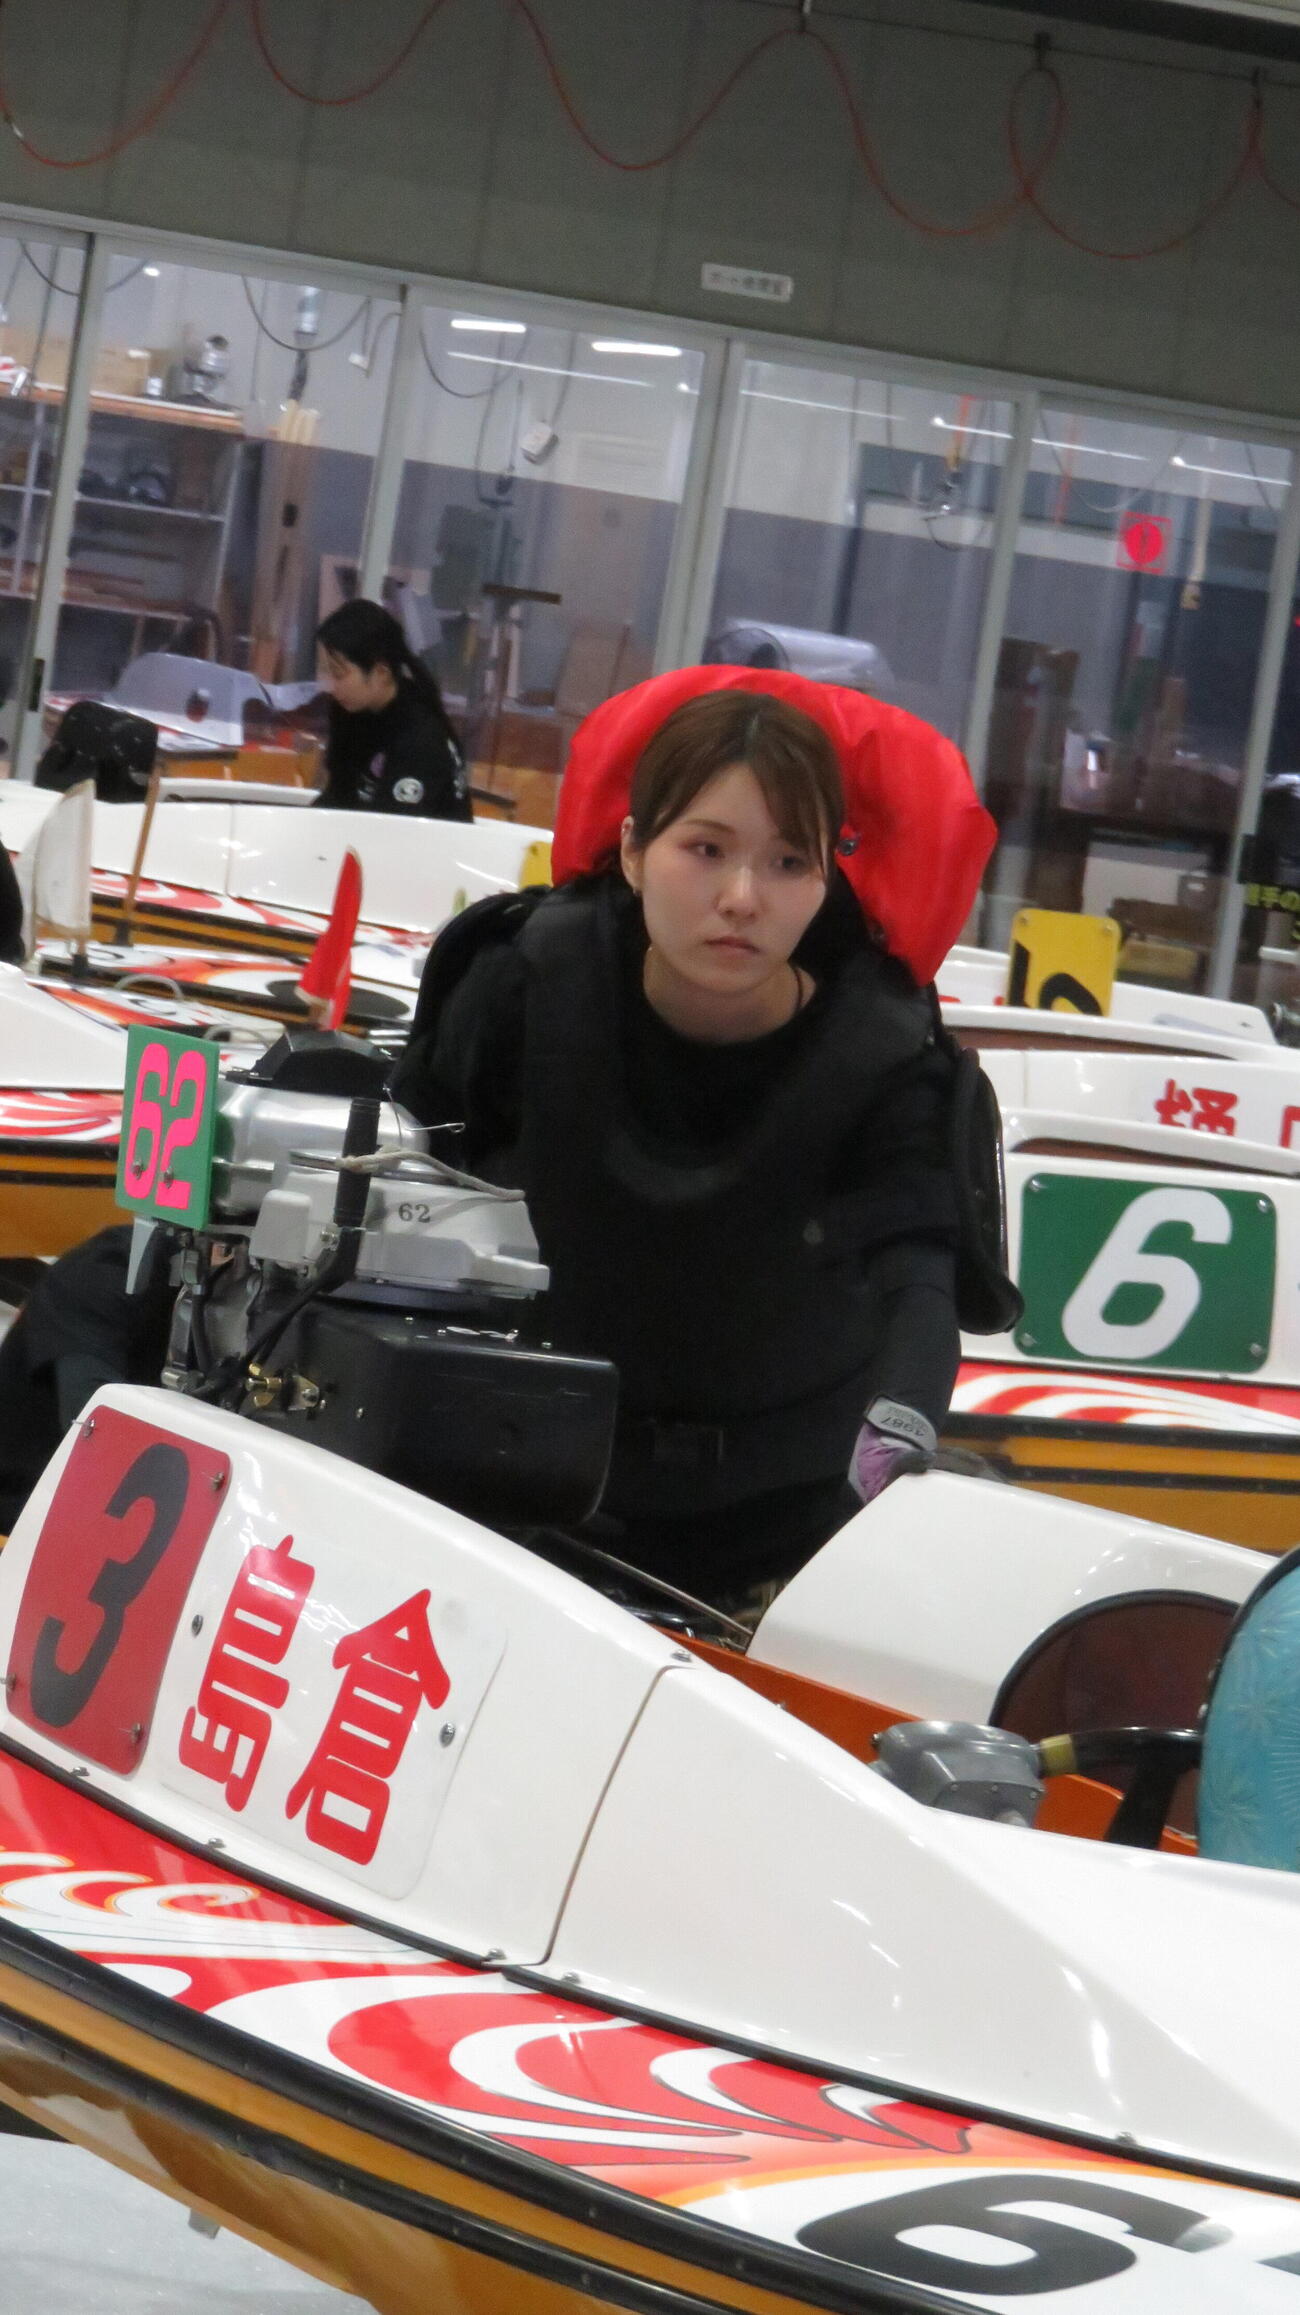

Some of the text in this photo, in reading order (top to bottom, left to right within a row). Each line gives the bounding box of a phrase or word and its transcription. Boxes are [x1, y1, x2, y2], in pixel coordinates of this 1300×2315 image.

[124, 1043, 206, 1210] 62
[399, 1203, 431, 1223] 62
[1062, 1187, 1232, 1359] 6
[30, 1443, 190, 1729] 3
[178, 1534, 451, 1866] 島倉
